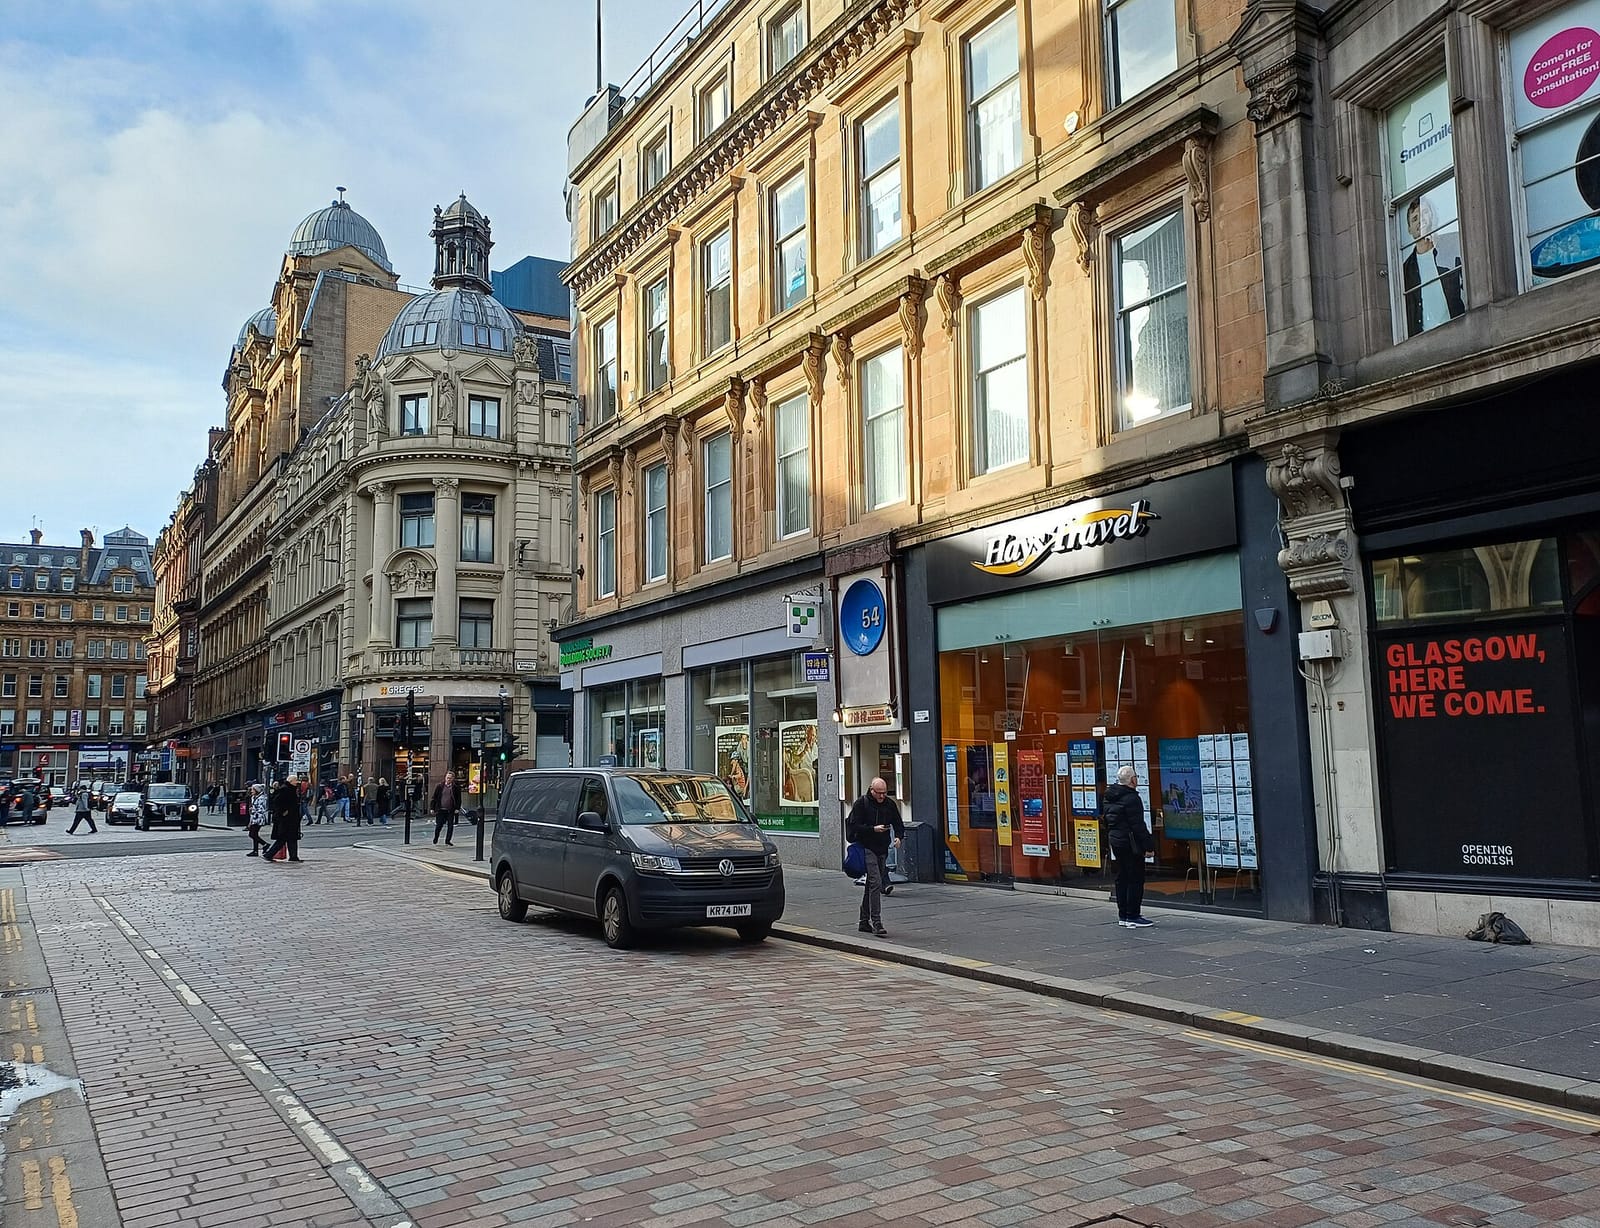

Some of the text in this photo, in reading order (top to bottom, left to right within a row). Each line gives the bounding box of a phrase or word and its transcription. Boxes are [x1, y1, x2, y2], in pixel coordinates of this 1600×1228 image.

[1533, 39, 1593, 72] Come in for
[1536, 51, 1592, 85] your FREE
[1530, 60, 1600, 98] consultation!
[1052, 500, 1146, 553] Travel
[862, 606, 880, 628] 54
[1386, 634, 1546, 667] GLASGOW,
[1388, 666, 1466, 693] HERE
[1390, 689, 1546, 719] WE COME.
[1020, 777, 1044, 788] FREE
[1461, 844, 1513, 855] OPENING
[1463, 854, 1514, 866] SOONISH
[709, 906, 731, 916] KR74
